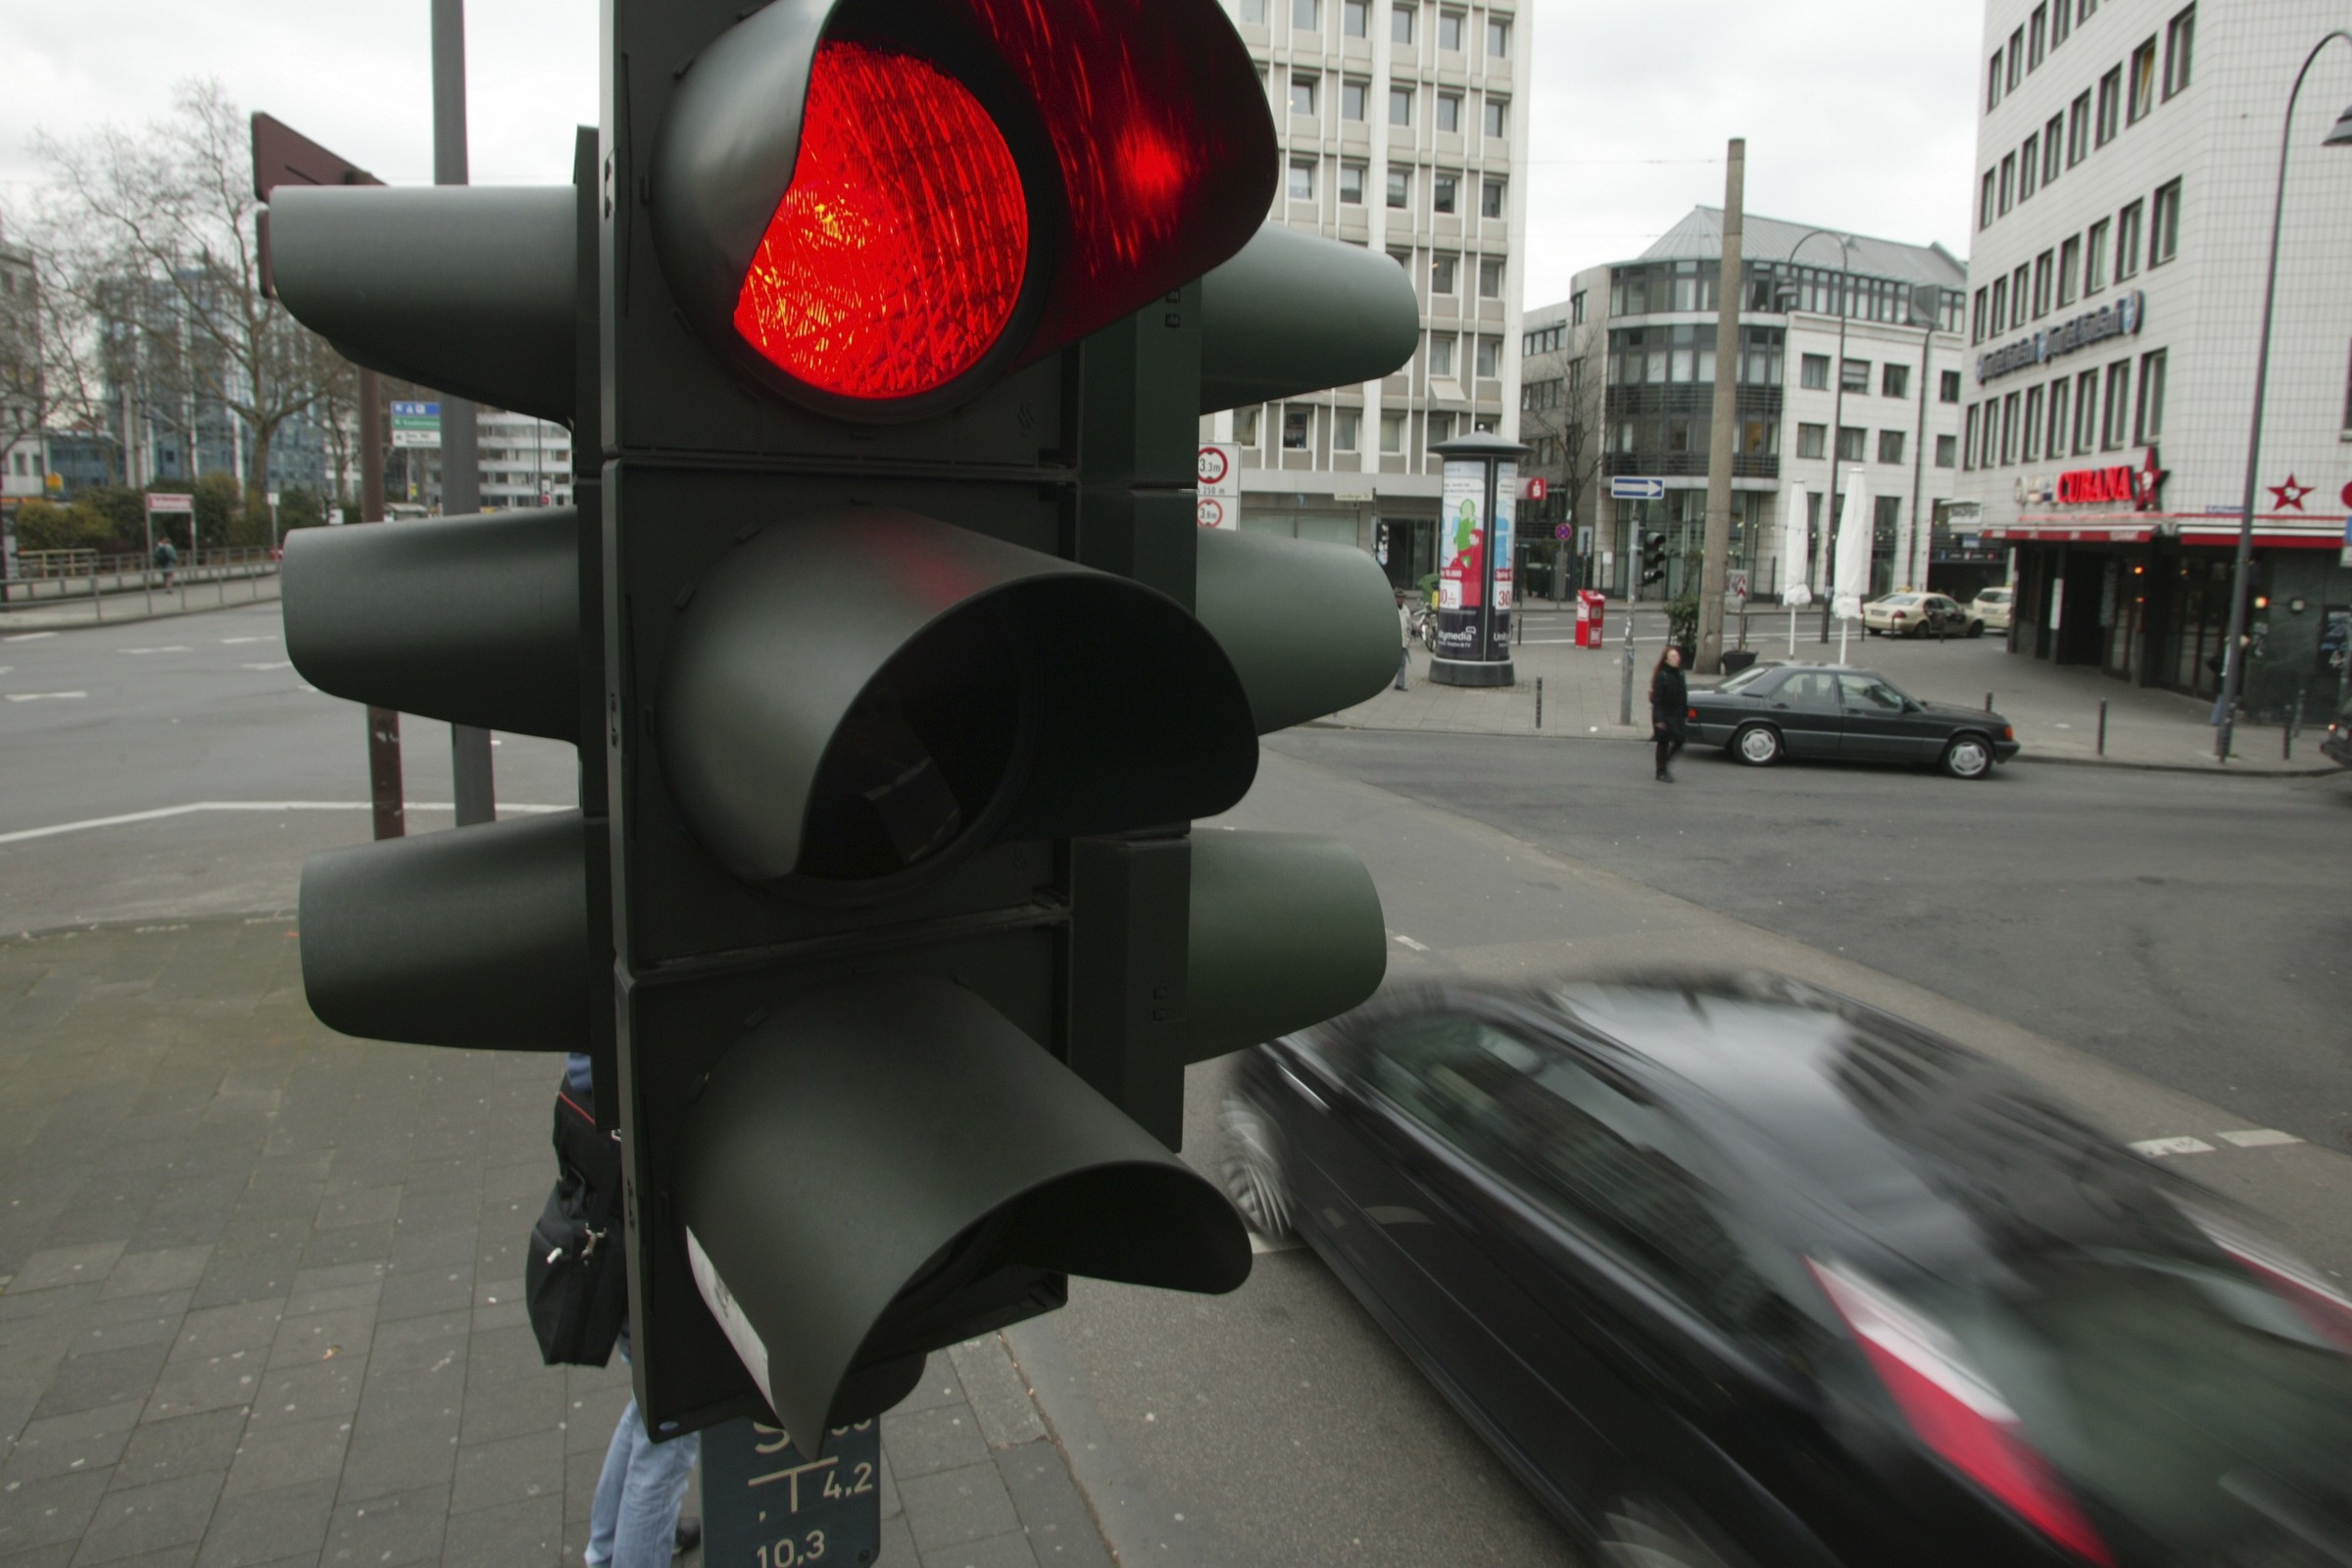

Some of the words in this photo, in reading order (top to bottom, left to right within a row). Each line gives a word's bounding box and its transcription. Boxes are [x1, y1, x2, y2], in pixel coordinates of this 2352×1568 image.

[2056, 465, 2133, 505] CUBANA
[822, 1461, 873, 1500] 4,2
[756, 1529, 825, 1568] 10,3
